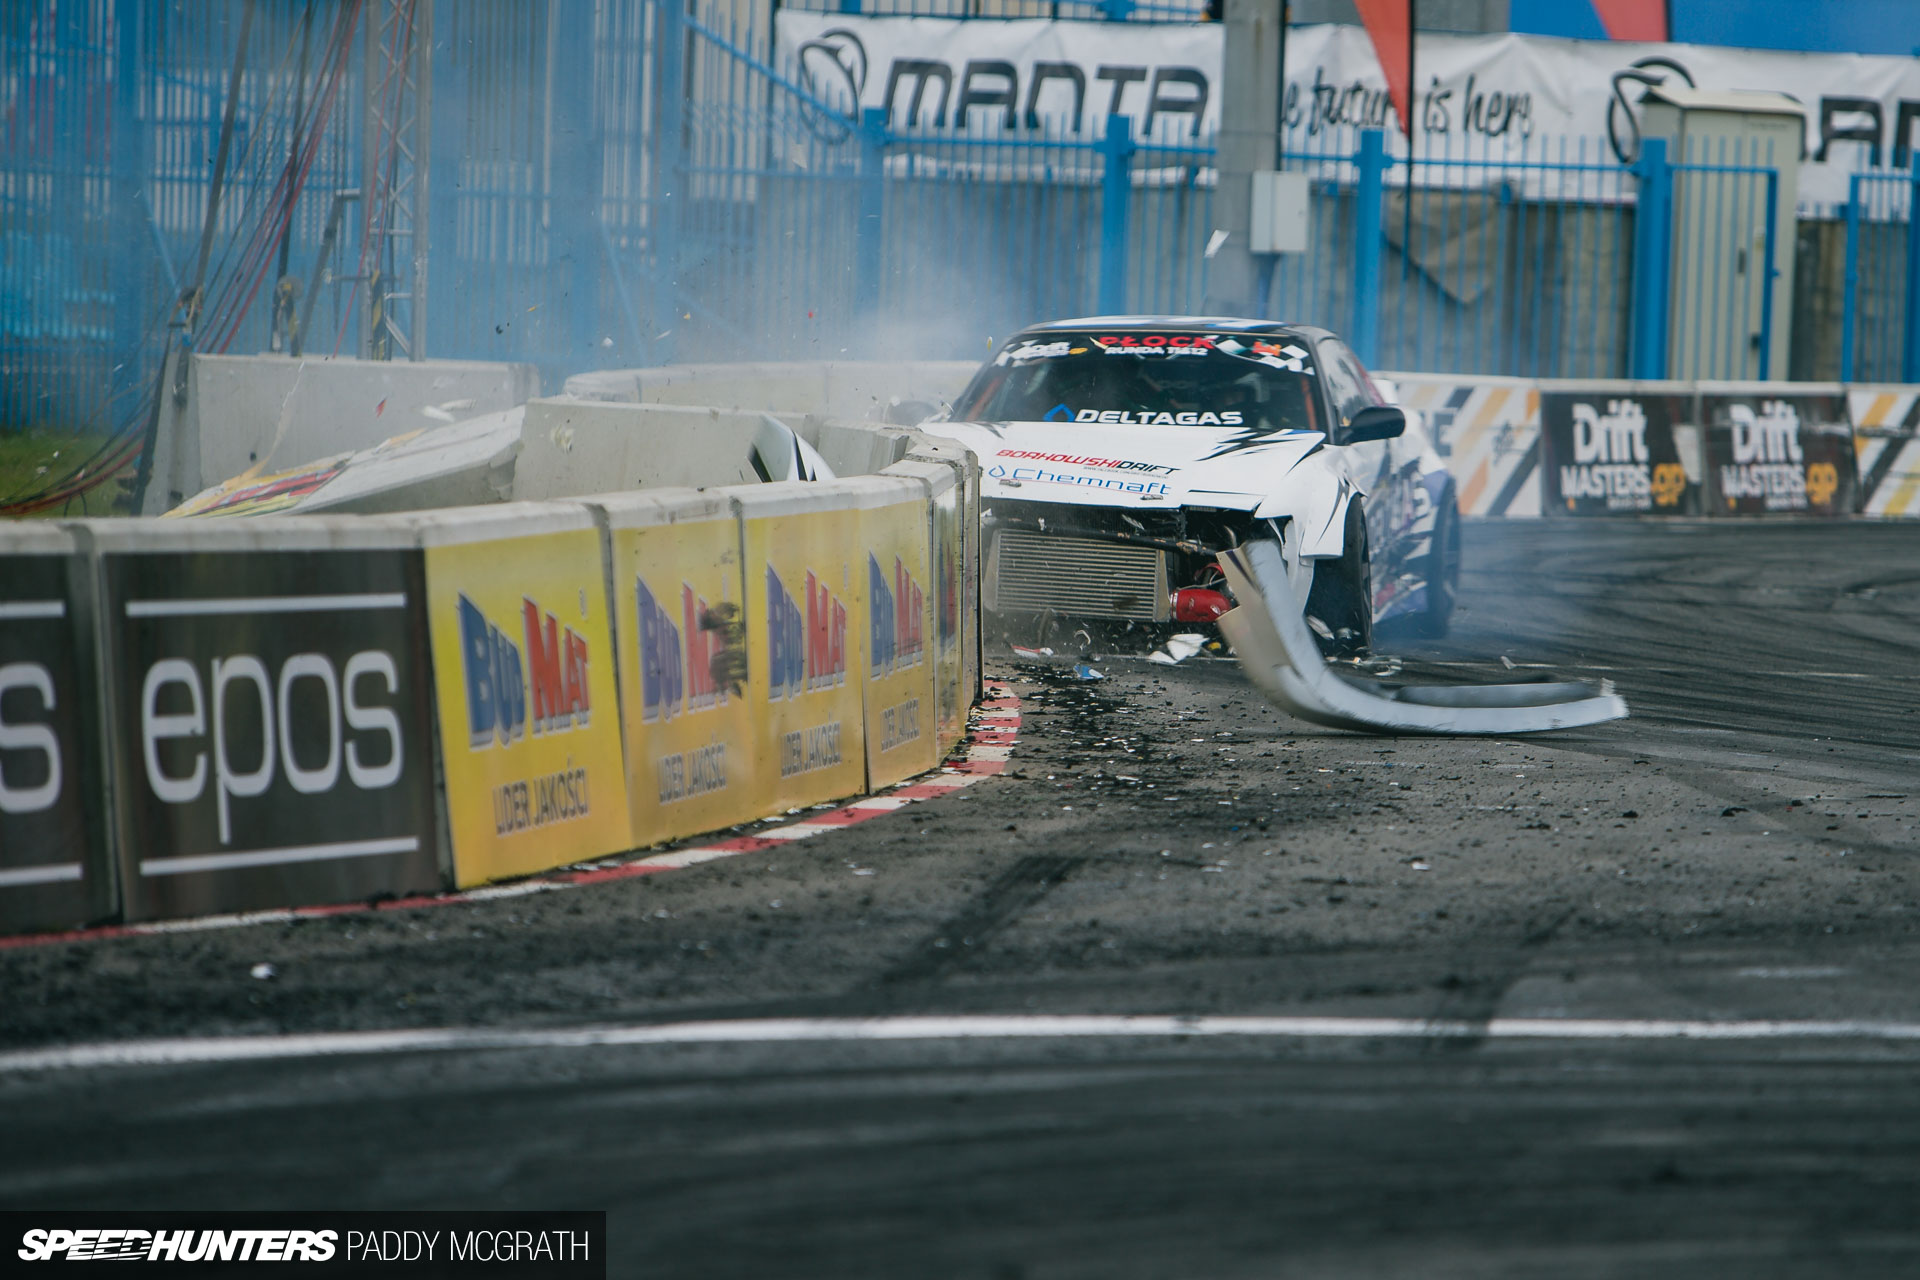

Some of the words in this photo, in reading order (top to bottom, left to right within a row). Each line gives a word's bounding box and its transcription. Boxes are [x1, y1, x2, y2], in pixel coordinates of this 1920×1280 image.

[885, 58, 1210, 137] MANTA
[1423, 75, 1453, 133] is
[1098, 335, 1216, 350] PŁOCK
[1074, 408, 1244, 426] DELTAGAS
[1572, 399, 1649, 463] Drift
[1729, 400, 1804, 463] Drift
[1012, 467, 1173, 496] Chemnaft
[1561, 464, 1651, 498] MASTERS
[1721, 464, 1806, 498] MASTERS
[141, 650, 404, 844] epos
[493, 778, 531, 837] LIDER
